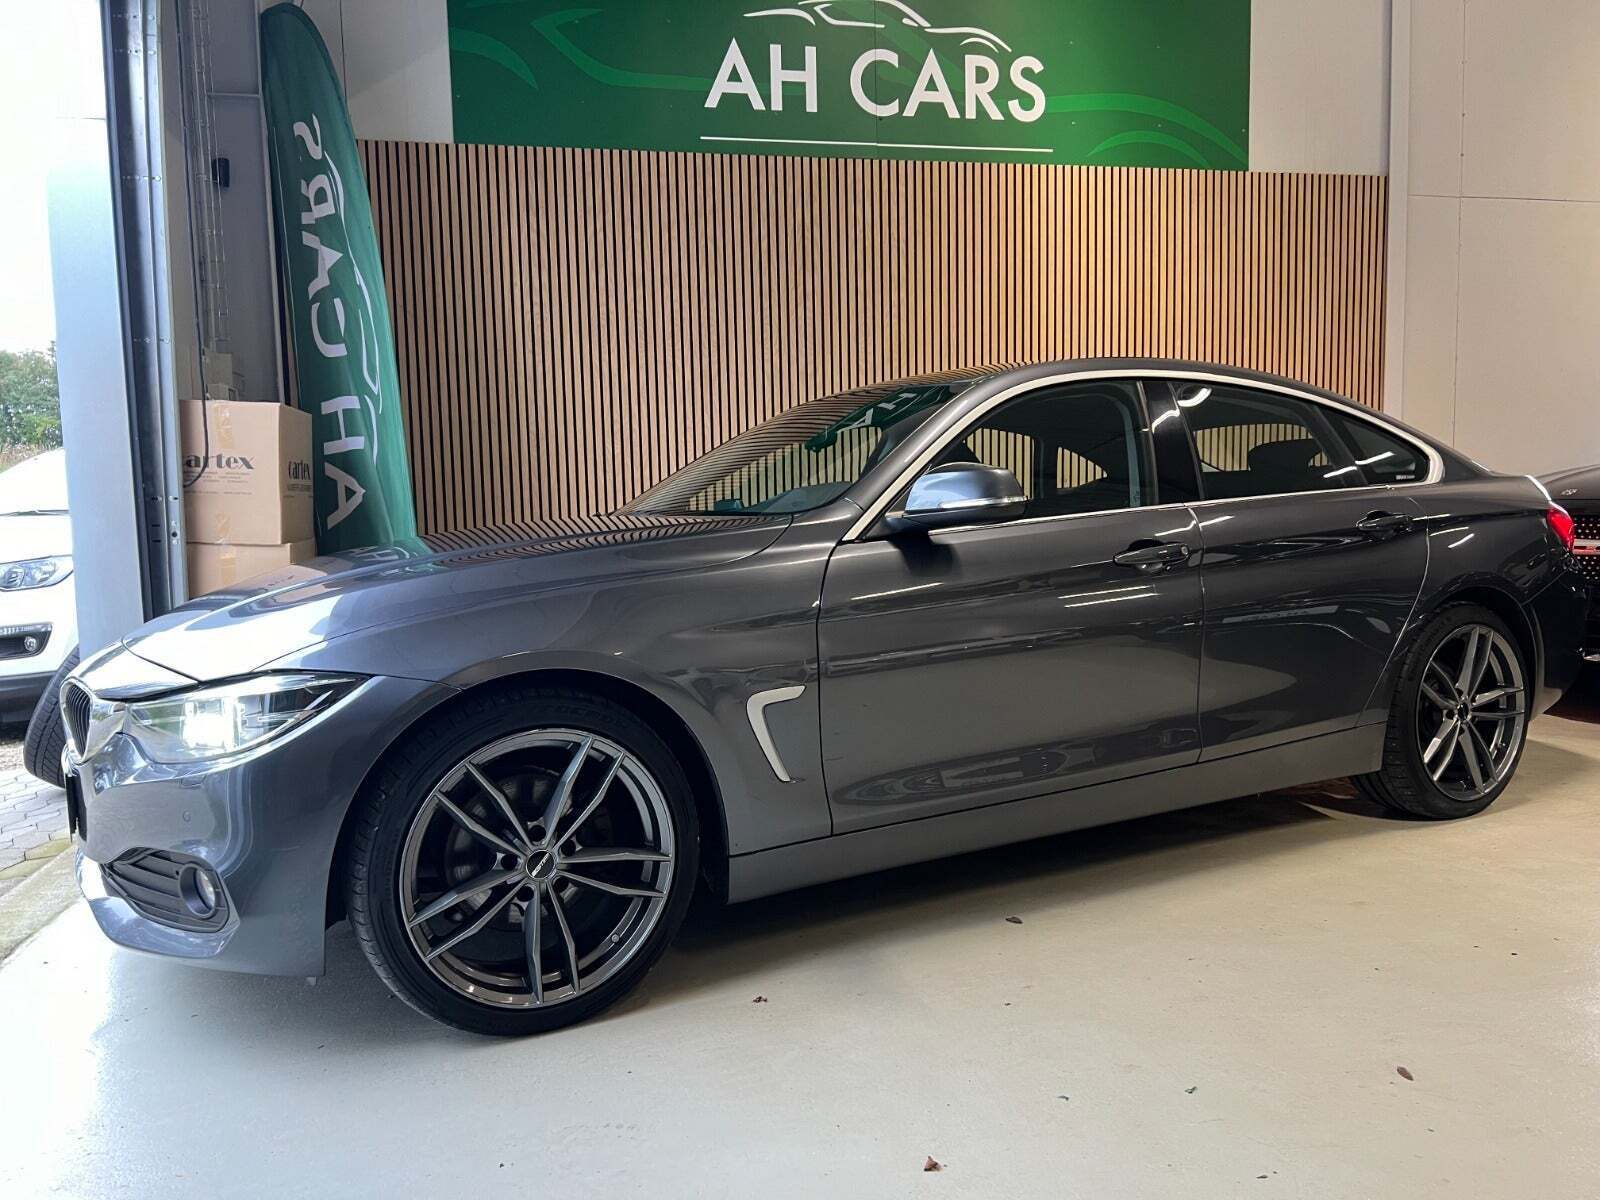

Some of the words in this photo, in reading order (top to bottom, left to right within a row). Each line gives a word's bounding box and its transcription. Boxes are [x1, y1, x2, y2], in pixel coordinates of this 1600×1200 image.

[704, 37, 818, 113] AH
[849, 48, 1046, 123] CARS
[184, 453, 255, 469] artex
